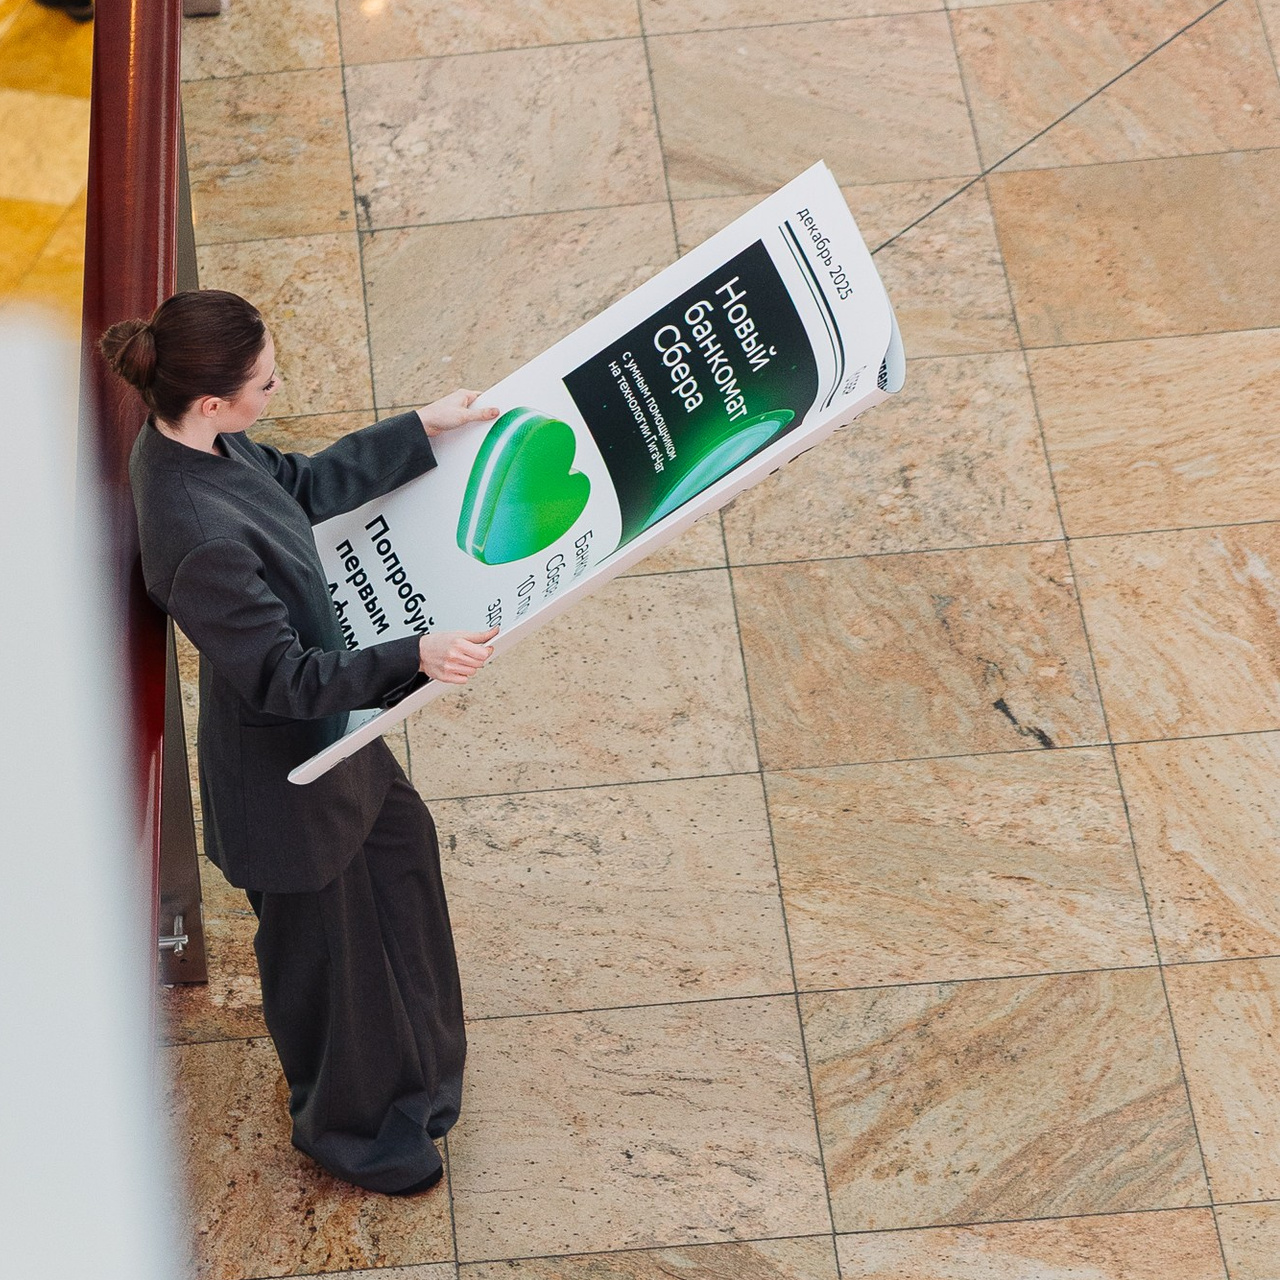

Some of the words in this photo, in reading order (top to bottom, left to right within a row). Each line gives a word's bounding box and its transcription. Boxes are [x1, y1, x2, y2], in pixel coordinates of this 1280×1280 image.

[796, 208, 833, 267] декабрь
[829, 265, 853, 300] 2025
[622, 352, 632, 361] с
[653, 324, 704, 413] Сбера
[684, 300, 748, 422] банкомат
[715, 276, 777, 372] Новый
[608, 361, 622, 378] на
[617, 376, 652, 439] технологии
[645, 434, 665, 474] ГигаЧат
[624, 358, 652, 398] умным
[646, 396, 677, 461] помощником
[335, 539, 391, 635] первым
[364, 514, 435, 637] Попробуй
[485, 598, 503, 628] здо
[516, 574, 536, 597] 10
